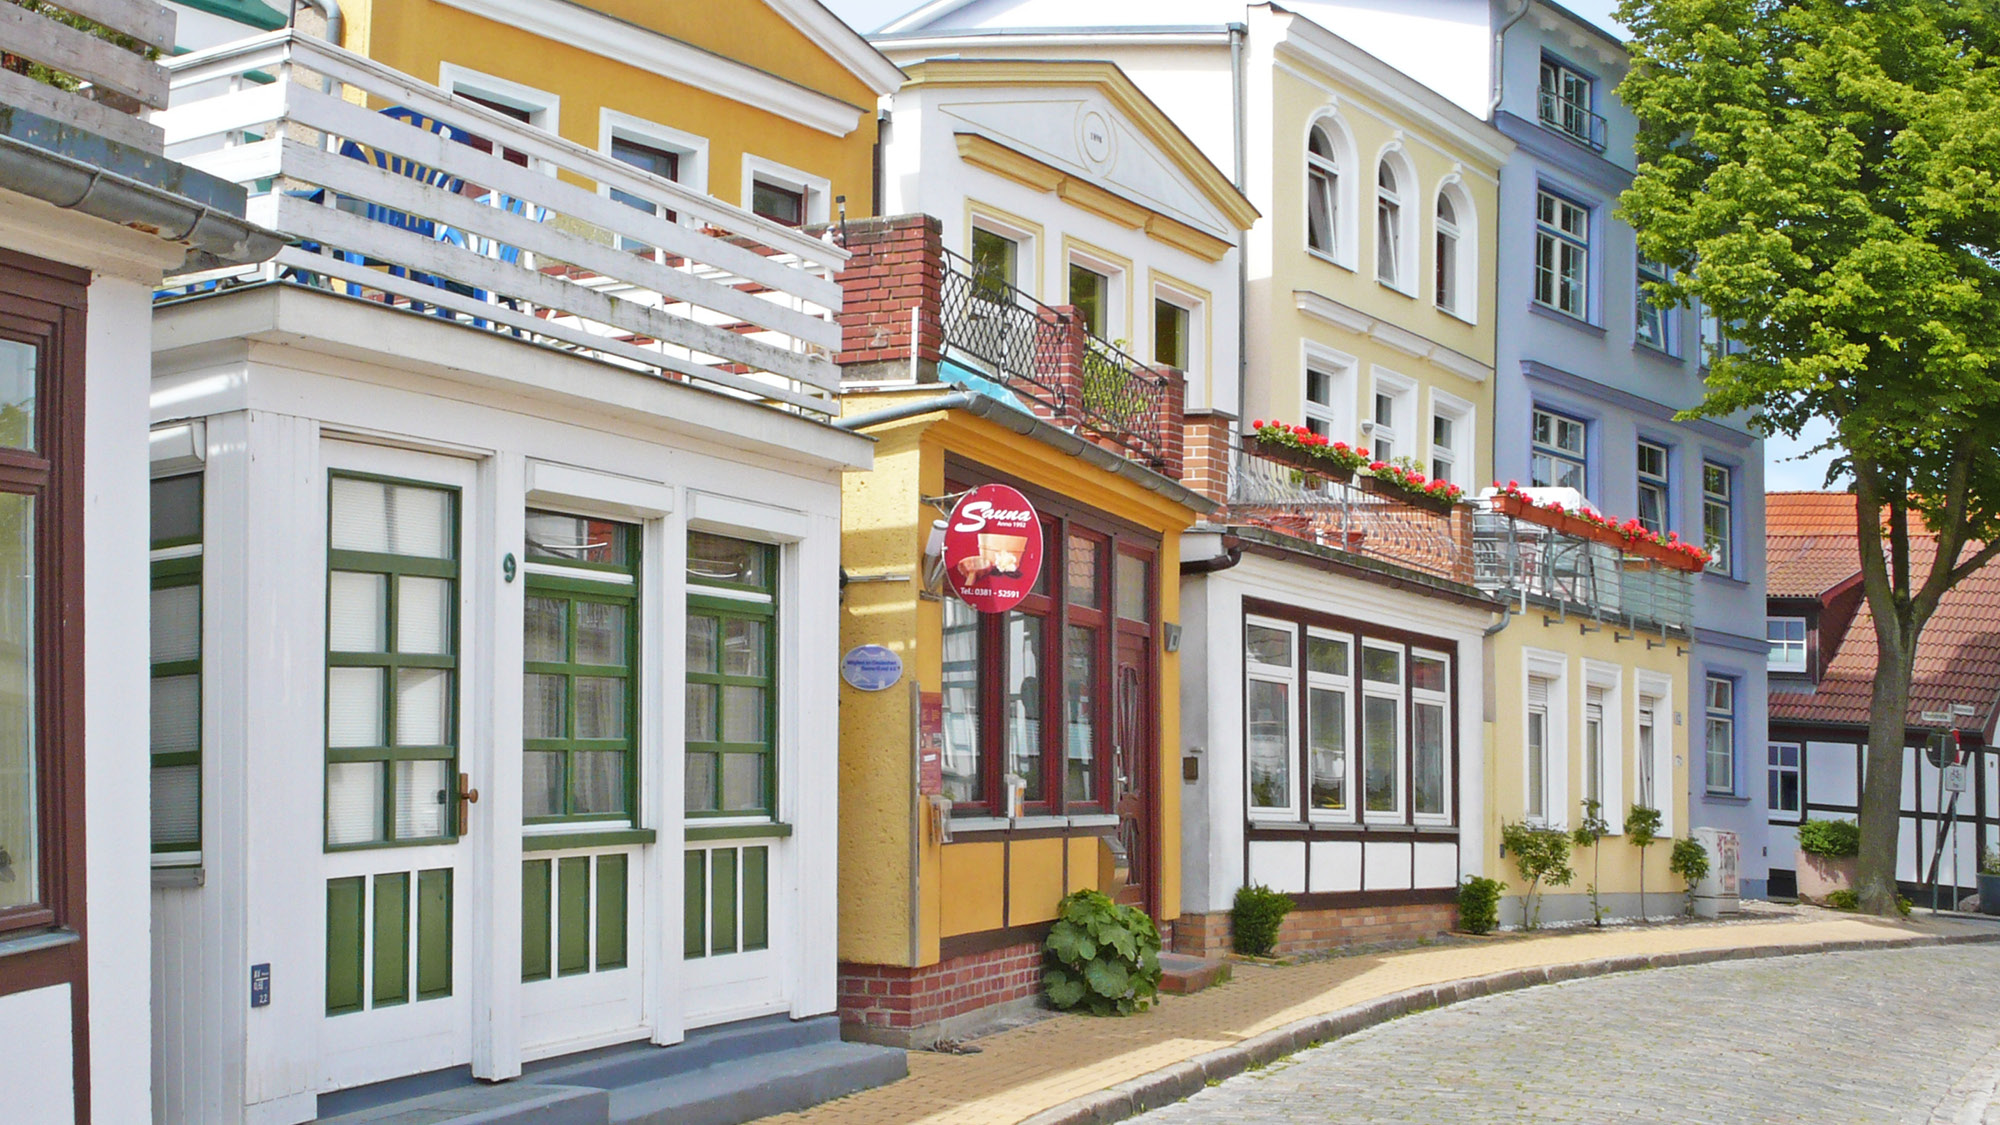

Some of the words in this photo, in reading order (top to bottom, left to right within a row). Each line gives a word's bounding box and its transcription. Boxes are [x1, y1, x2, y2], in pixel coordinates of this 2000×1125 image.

[954, 501, 1032, 532] Sauna
[503, 552, 517, 583] 9
[974, 588, 992, 597] 0381
[998, 589, 1020, 598] 52591
